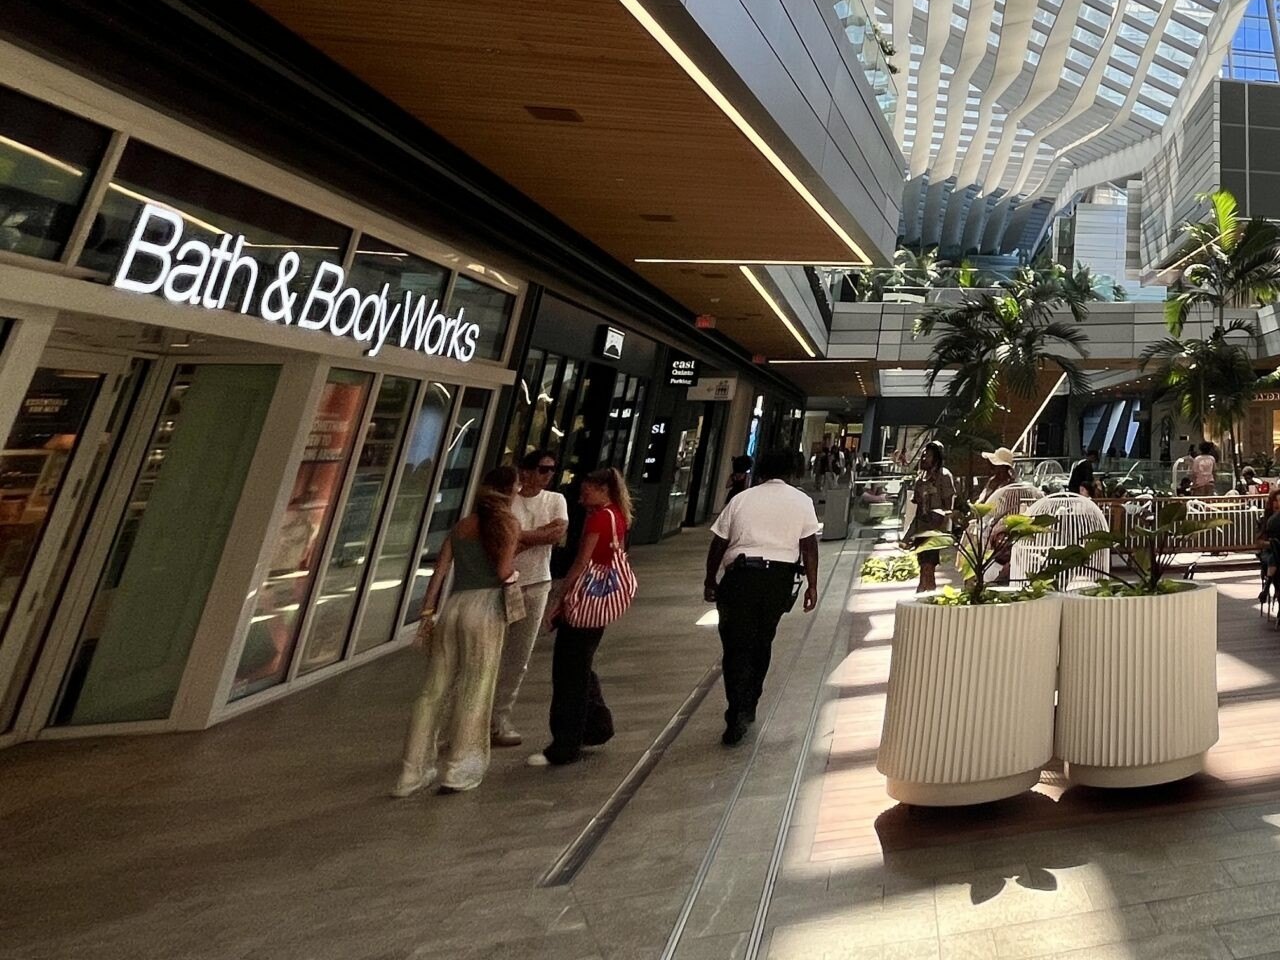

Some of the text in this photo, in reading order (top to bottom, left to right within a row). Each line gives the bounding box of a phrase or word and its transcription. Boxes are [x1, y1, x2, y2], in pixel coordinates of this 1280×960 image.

[114, 201, 481, 362] Bath & Body Works
[672, 360, 695, 369] east
